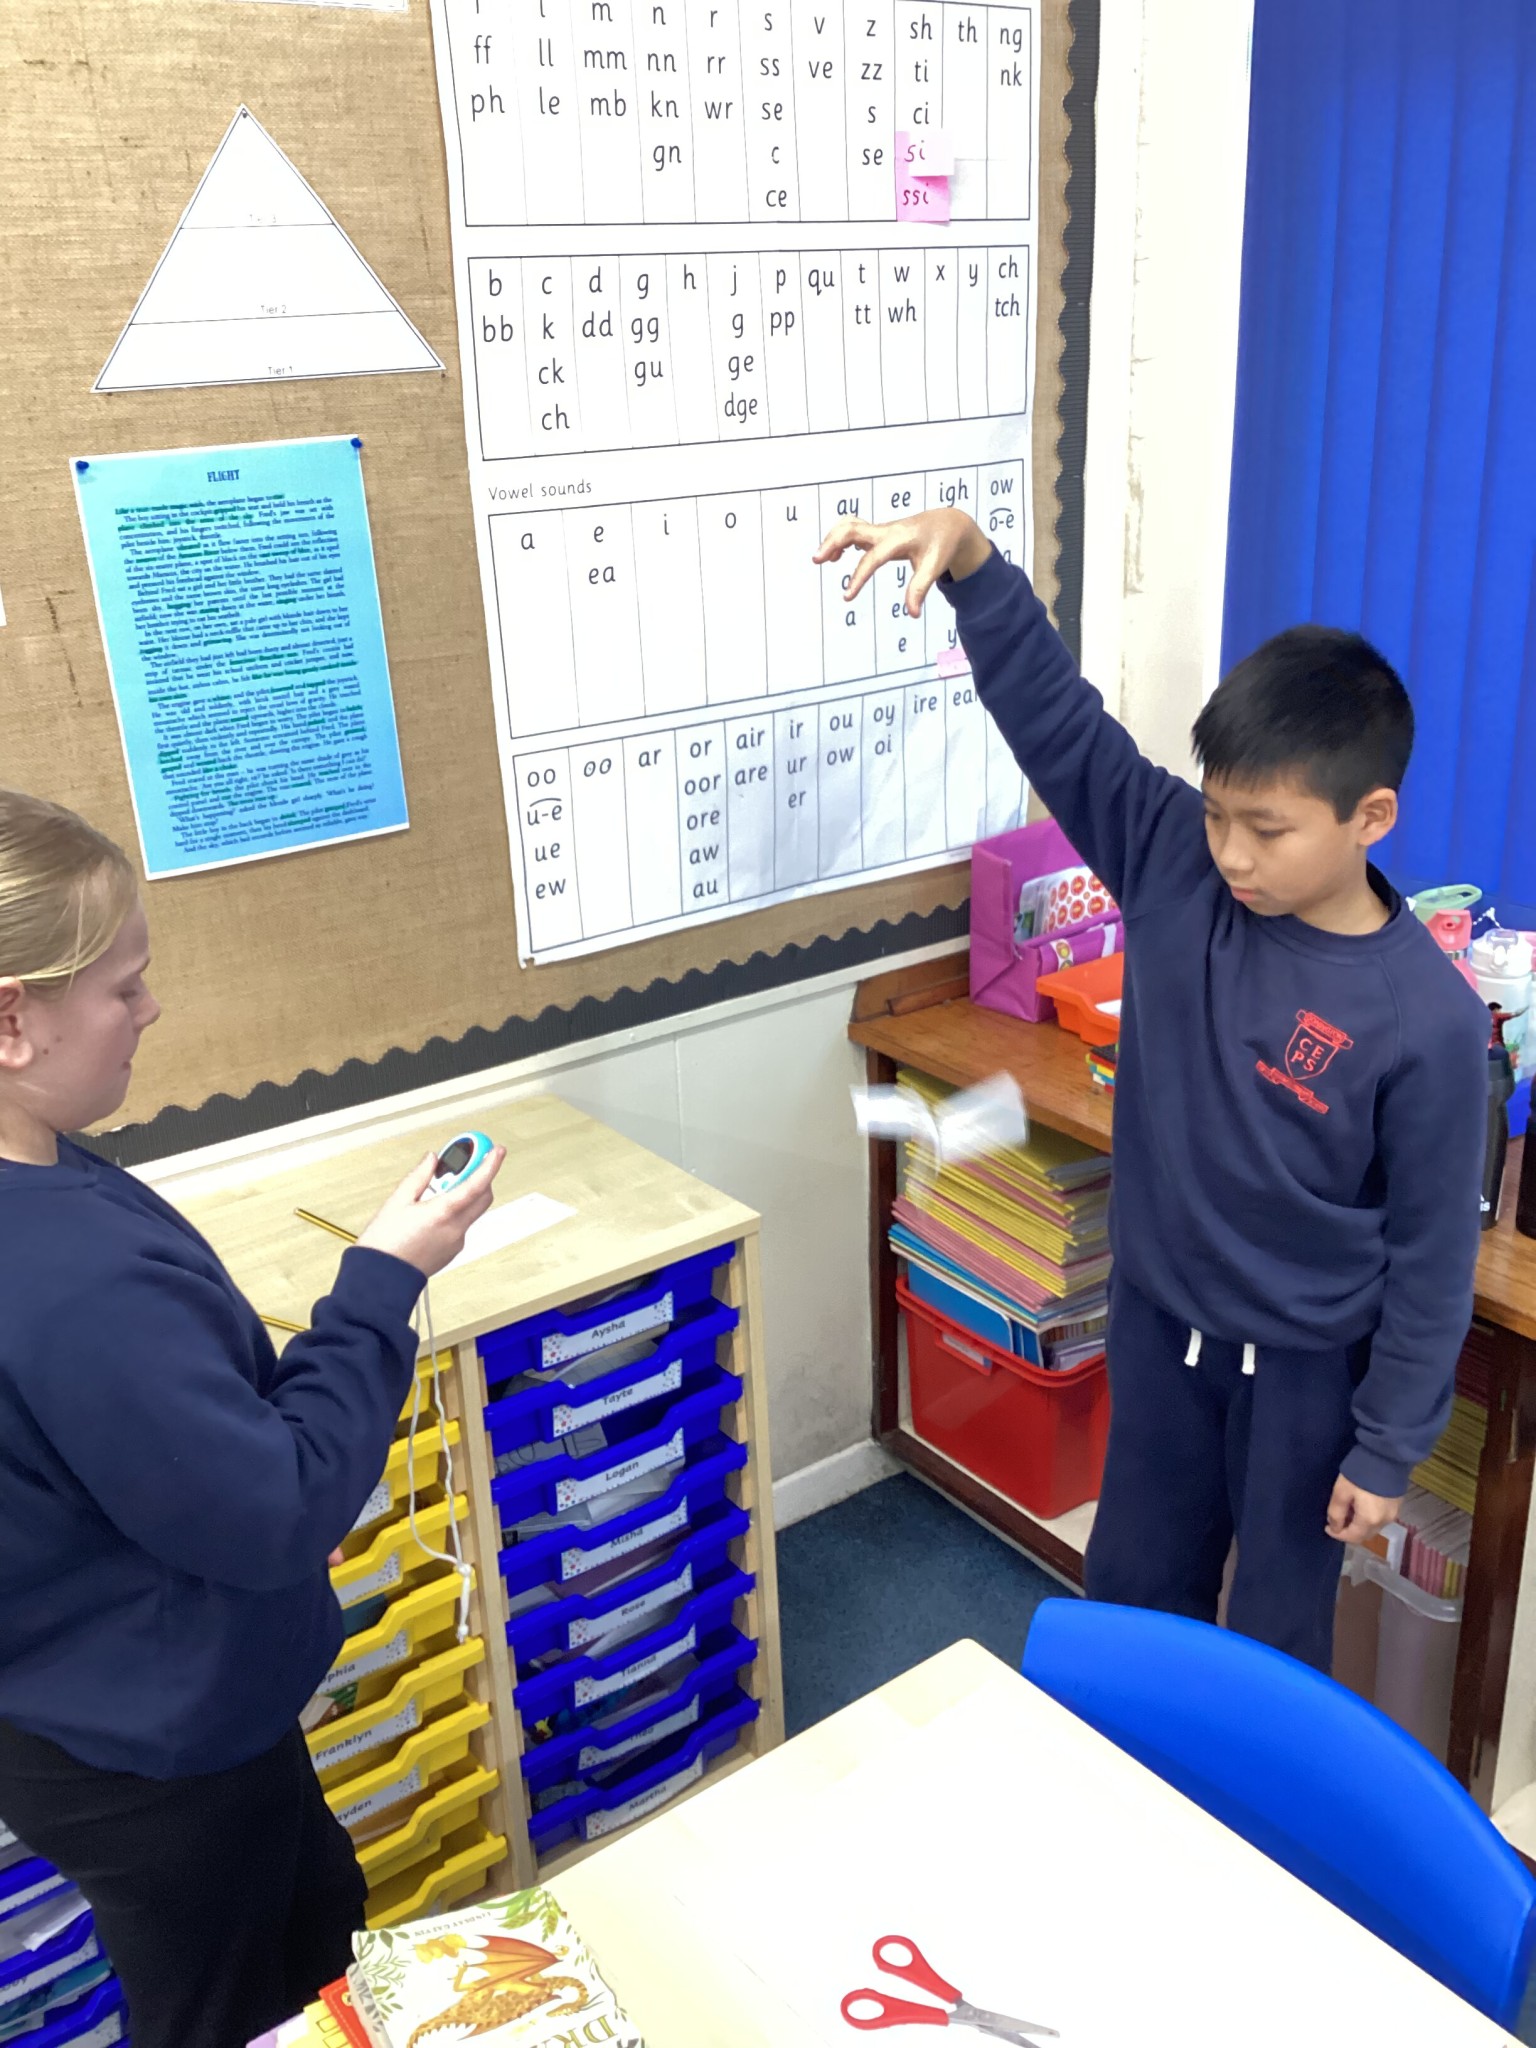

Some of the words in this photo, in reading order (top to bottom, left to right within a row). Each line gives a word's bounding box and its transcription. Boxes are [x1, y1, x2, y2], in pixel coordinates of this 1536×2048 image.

[591, 1, 614, 23] m
[652, 6, 667, 26] n
[710, 10, 718, 28] r
[764, 12, 773, 32] s
[813, 16, 826, 35] v
[866, 19, 877, 37] z
[909, 13, 933, 41] sh
[957, 16, 978, 44] th
[473, 34, 493, 65] ff
[999, 27, 1023, 54] ng
[538, 37, 555, 68] ll
[583, 49, 628, 71] mm
[647, 52, 677, 73] nn
[707, 55, 726, 75] rr
[759, 57, 780, 77] ss
[808, 60, 833, 80] ve
[860, 62, 883, 81] zz
[914, 58, 929, 83] ti
[1000, 61, 1023, 87] nk
[470, 87, 506, 123] ph
[539, 88, 561, 116] le
[590, 89, 627, 117] mb
[650, 89, 680, 119] kn
[704, 100, 734, 120] wr
[761, 102, 783, 122] se
[867, 105, 877, 124] s
[912, 101, 930, 125] ci
[652, 144, 682, 172] gn
[771, 145, 780, 165] c
[861, 147, 884, 166] se
[765, 189, 788, 208] ce
[683, 263, 697, 290] h
[858, 263, 866, 284] t
[893, 265, 911, 283] w
[935, 264, 946, 282] x
[968, 263, 978, 288] y
[998, 254, 1019, 279] ch
[488, 268, 503, 297] b
[541, 275, 553, 295] c
[588, 265, 603, 294] d
[636, 273, 649, 300] g
[729, 264, 737, 297] j
[776, 268, 787, 295] p
[807, 268, 835, 297] qu
[260, 305, 278, 314] Tier
[281, 304, 287, 314] 2
[854, 303, 872, 325] tt
[887, 297, 917, 324] wh
[994, 292, 1021, 318] tch
[482, 314, 514, 343] bb
[542, 312, 556, 340] k
[581, 309, 614, 339] dd
[630, 316, 659, 344] gg
[731, 313, 744, 339] g
[770, 310, 795, 337] pp
[267, 366, 285, 375] Tier
[538, 357, 565, 385] ck
[634, 360, 664, 388] gu
[727, 354, 754, 382] ge
[541, 403, 571, 431] ch
[724, 391, 758, 424] dge
[206, 469, 240, 483] FLIGHT
[488, 483, 534, 501] Vowel
[540, 479, 592, 497] sounds
[939, 477, 969, 508] igh
[990, 478, 1014, 496] ow
[836, 497, 859, 519] ay
[890, 490, 912, 509] ee
[724, 512, 737, 529] o
[786, 505, 798, 522] u
[593, 525, 605, 544] e
[662, 513, 670, 536] i
[520, 532, 536, 551] a
[588, 565, 616, 585] ea
[896, 565, 906, 589] y
[845, 610, 857, 627] a
[897, 636, 907, 653] e
[913, 694, 938, 715] ire
[829, 713, 853, 732] ou
[873, 704, 896, 727] oy
[735, 727, 765, 750] air
[789, 719, 804, 740] ir
[689, 739, 713, 759] or
[826, 746, 855, 766] ow
[874, 738, 892, 756] oi
[583, 757, 612, 778] oo
[638, 748, 662, 768] ar
[787, 756, 807, 775] ur
[527, 768, 556, 788] oo
[684, 774, 722, 796] oor
[734, 765, 768, 786] are
[787, 790, 807, 809] er
[686, 809, 721, 831] ore
[534, 842, 561, 863] ue
[689, 844, 720, 865] aw
[535, 878, 567, 900] ew
[692, 879, 719, 899] au
[591, 1320, 626, 1339] Aysha
[605, 1460, 640, 1481] Logan
[610, 1528, 644, 1549] Misha
[621, 1600, 646, 1617] Rose
[315, 1730, 372, 1760] Franklyn
[629, 1785, 667, 1811] Martha
